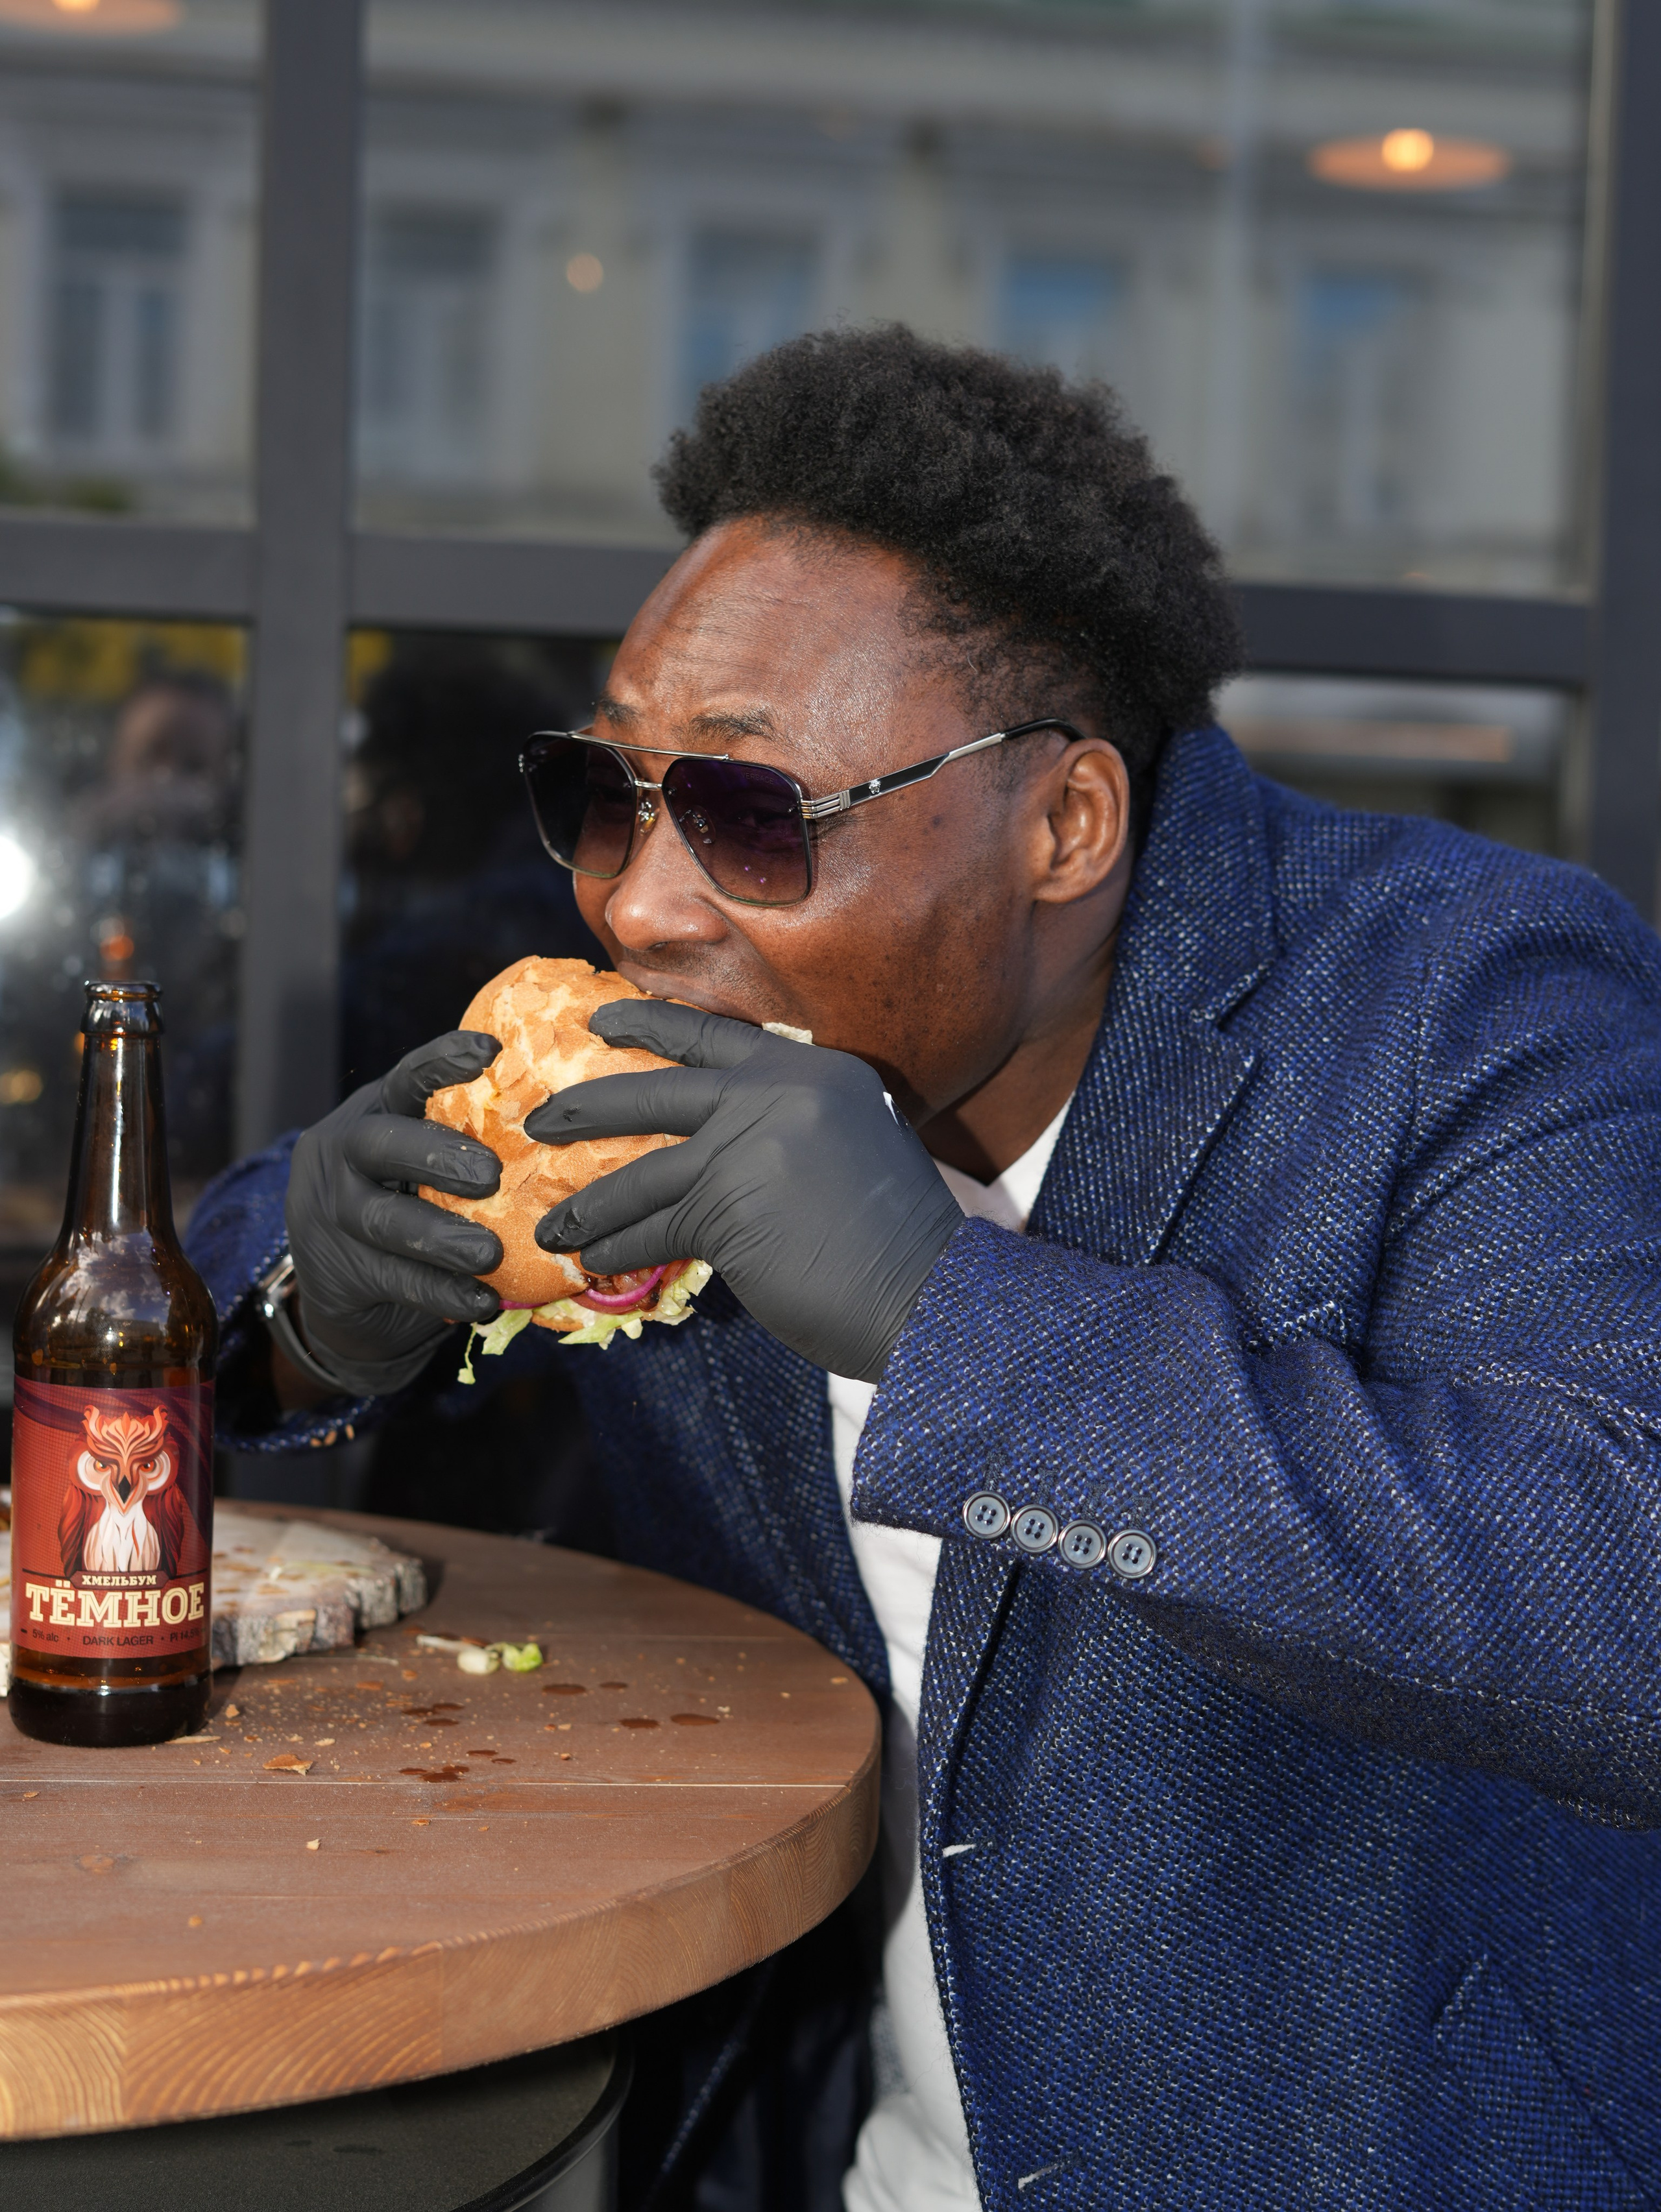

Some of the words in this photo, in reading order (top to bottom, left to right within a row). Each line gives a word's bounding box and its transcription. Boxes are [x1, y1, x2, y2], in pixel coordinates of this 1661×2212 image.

[741, 771, 775, 785] VERSACE
[82, 1574, 157, 1587] ХМЕЛЬБУМ
[25, 1579, 204, 1628] ТЁМНОЕ
[46, 1633, 59, 1642] alc
[82, 1635, 114, 1646] DARK
[117, 1635, 154, 1646] LAGER
